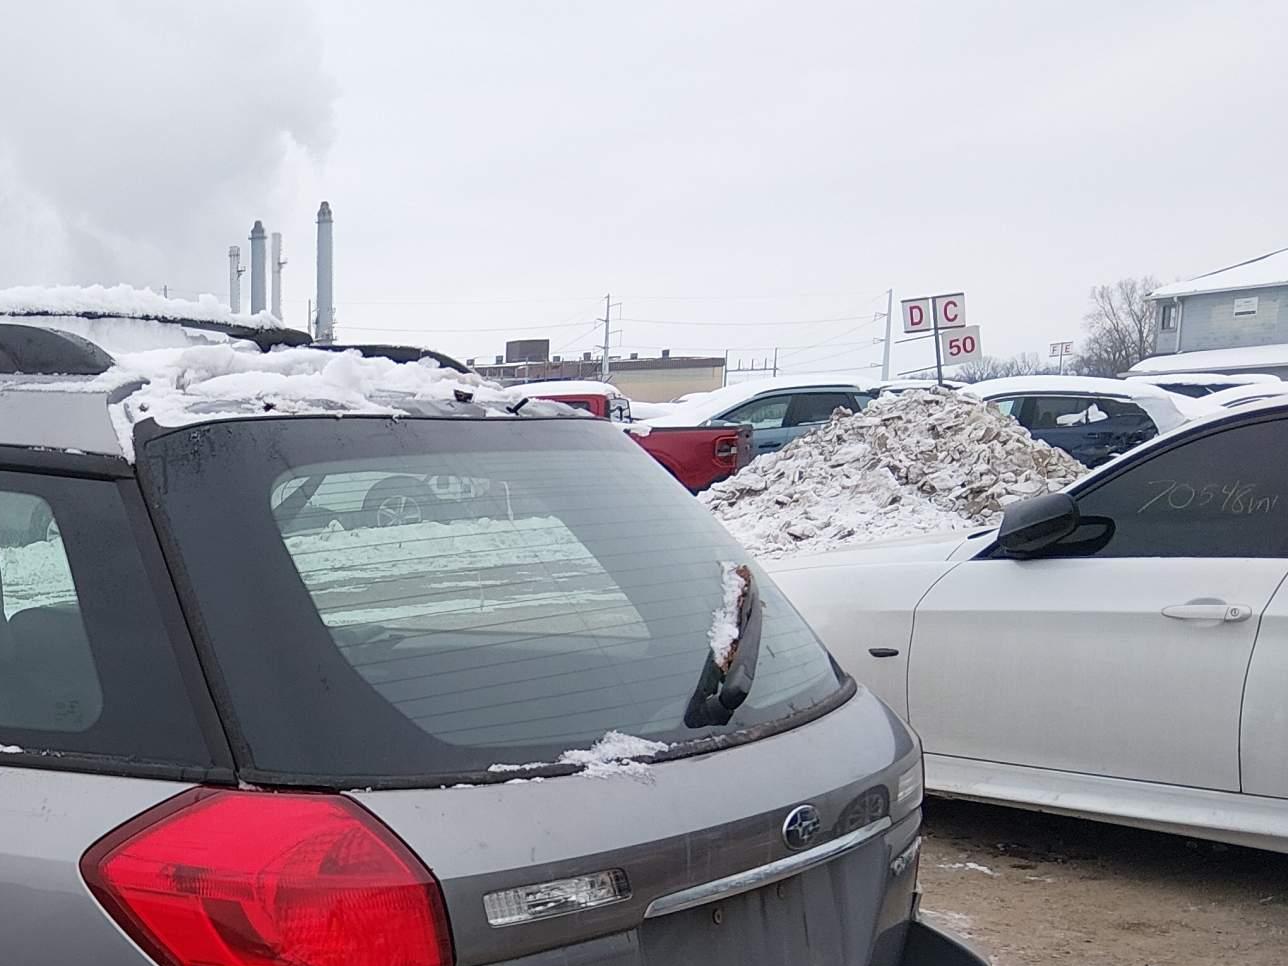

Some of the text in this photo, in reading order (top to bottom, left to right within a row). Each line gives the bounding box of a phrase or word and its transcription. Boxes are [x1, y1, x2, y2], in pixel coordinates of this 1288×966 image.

[909, 305, 923, 326] D
[944, 300, 958, 322] C
[949, 336, 975, 356] 50
